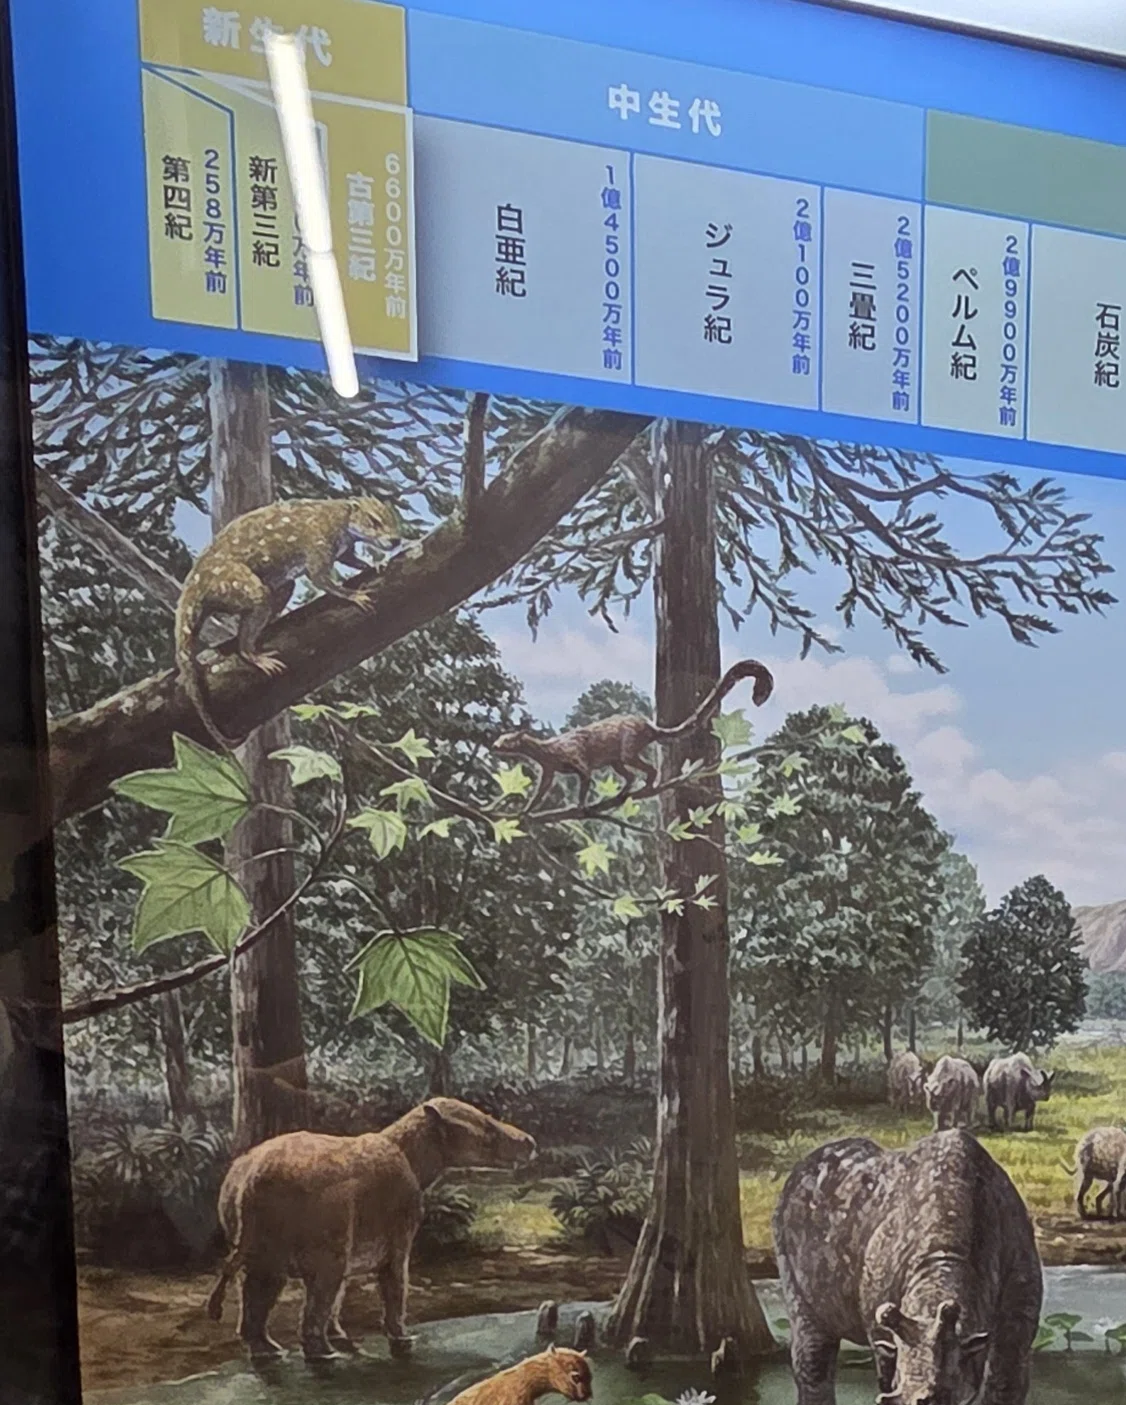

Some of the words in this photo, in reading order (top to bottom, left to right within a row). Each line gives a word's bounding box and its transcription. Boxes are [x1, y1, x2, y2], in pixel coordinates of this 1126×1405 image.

[607, 82, 723, 136] 中生代
[162, 155, 193, 242] 第四紀
[203, 149, 228, 295] 258万年前
[248, 156, 281, 268] 新第三紀
[346, 172, 377, 282] 古第三紀
[383, 152, 407, 319] 6600万年前
[495, 203, 528, 299] 白亜紀
[600, 165, 623, 371] 1億4500万年前
[703, 221, 733, 346] ジュラ紀
[792, 199, 812, 376] 2億100万年前
[848, 261, 877, 351] 三畳紀
[891, 216, 913, 413] 2億5200万年前
[950, 265, 979, 382] ペルム紀
[999, 236, 1020, 428] 2億9900万年前
[1094, 302, 1121, 390] 石炭紀
